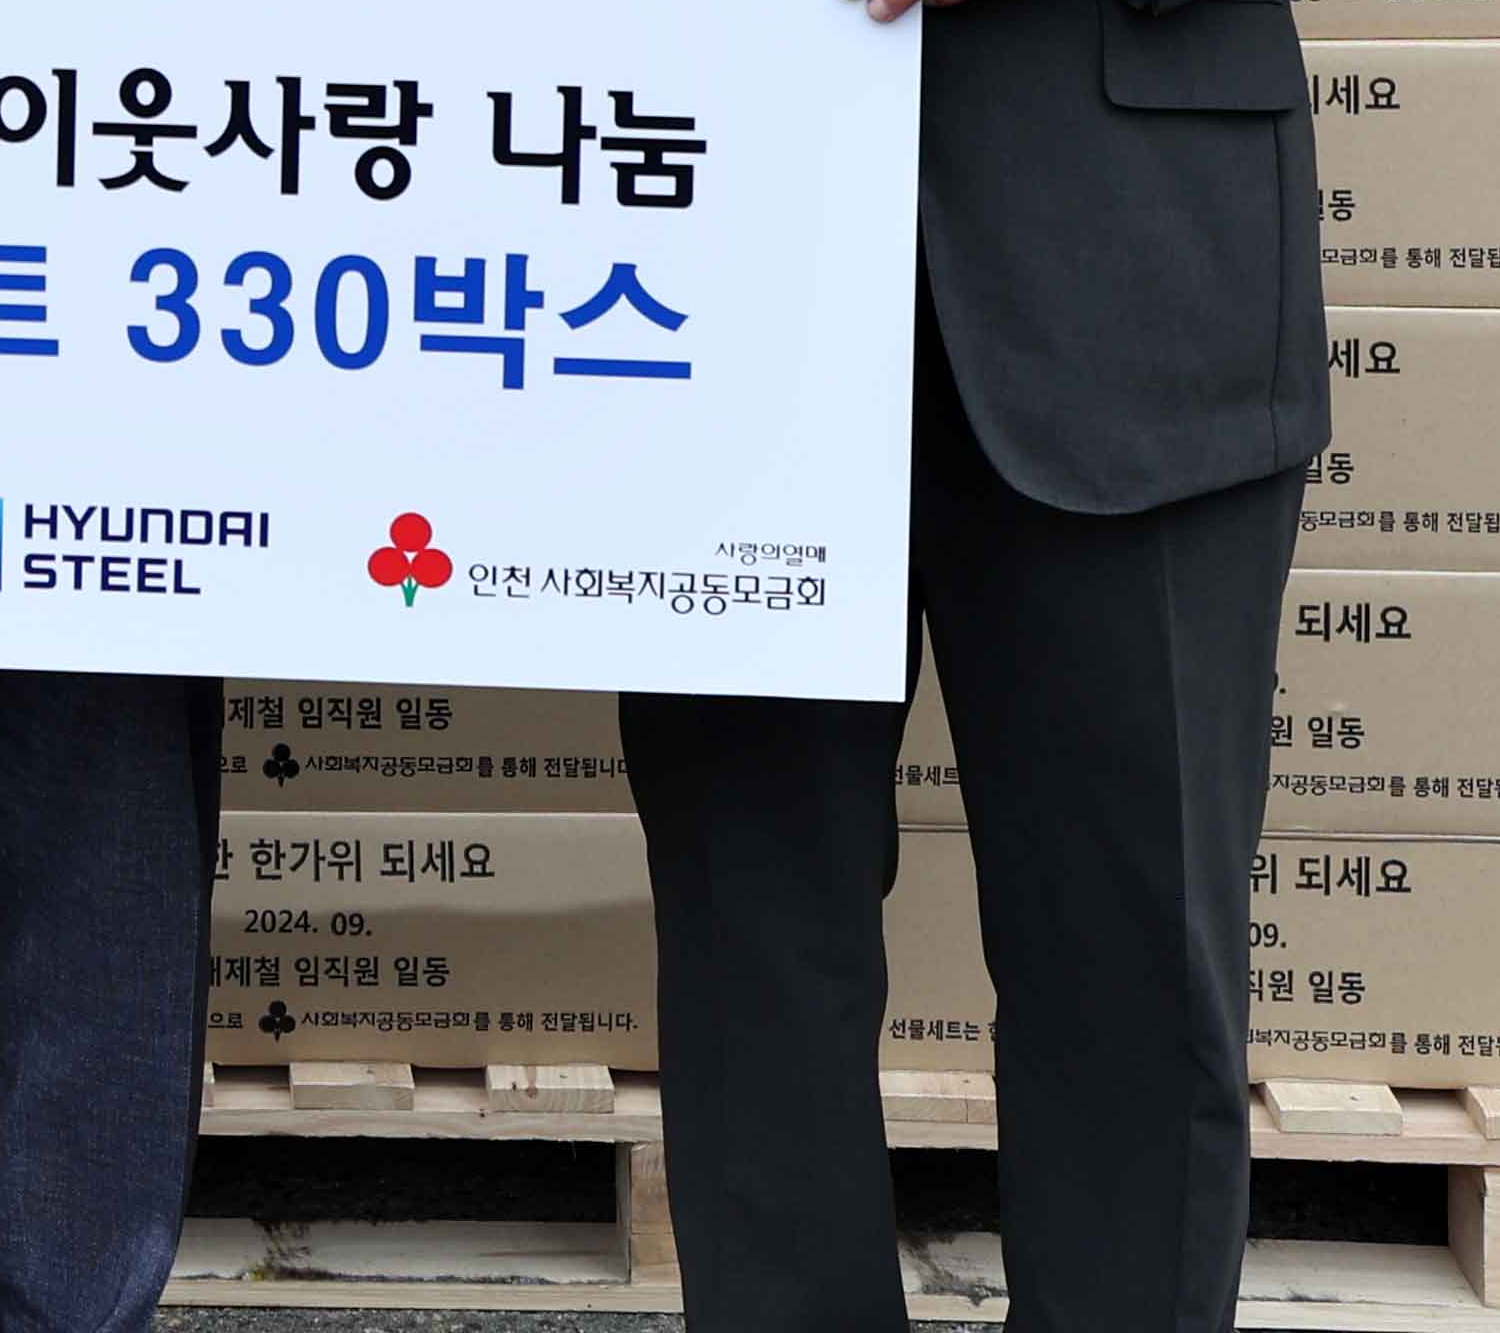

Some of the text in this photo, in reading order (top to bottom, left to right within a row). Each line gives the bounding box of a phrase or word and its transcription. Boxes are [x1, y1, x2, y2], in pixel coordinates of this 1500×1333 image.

[485, 84, 708, 210] 나눔
[126, 246, 693, 391] 330박스
[23, 502, 270, 549] HYUNDAI
[23, 552, 202, 595] STEEL
[715, 542, 827, 567] 사랑의열매
[467, 563, 826, 616] 인천 사회복지공동모금회
